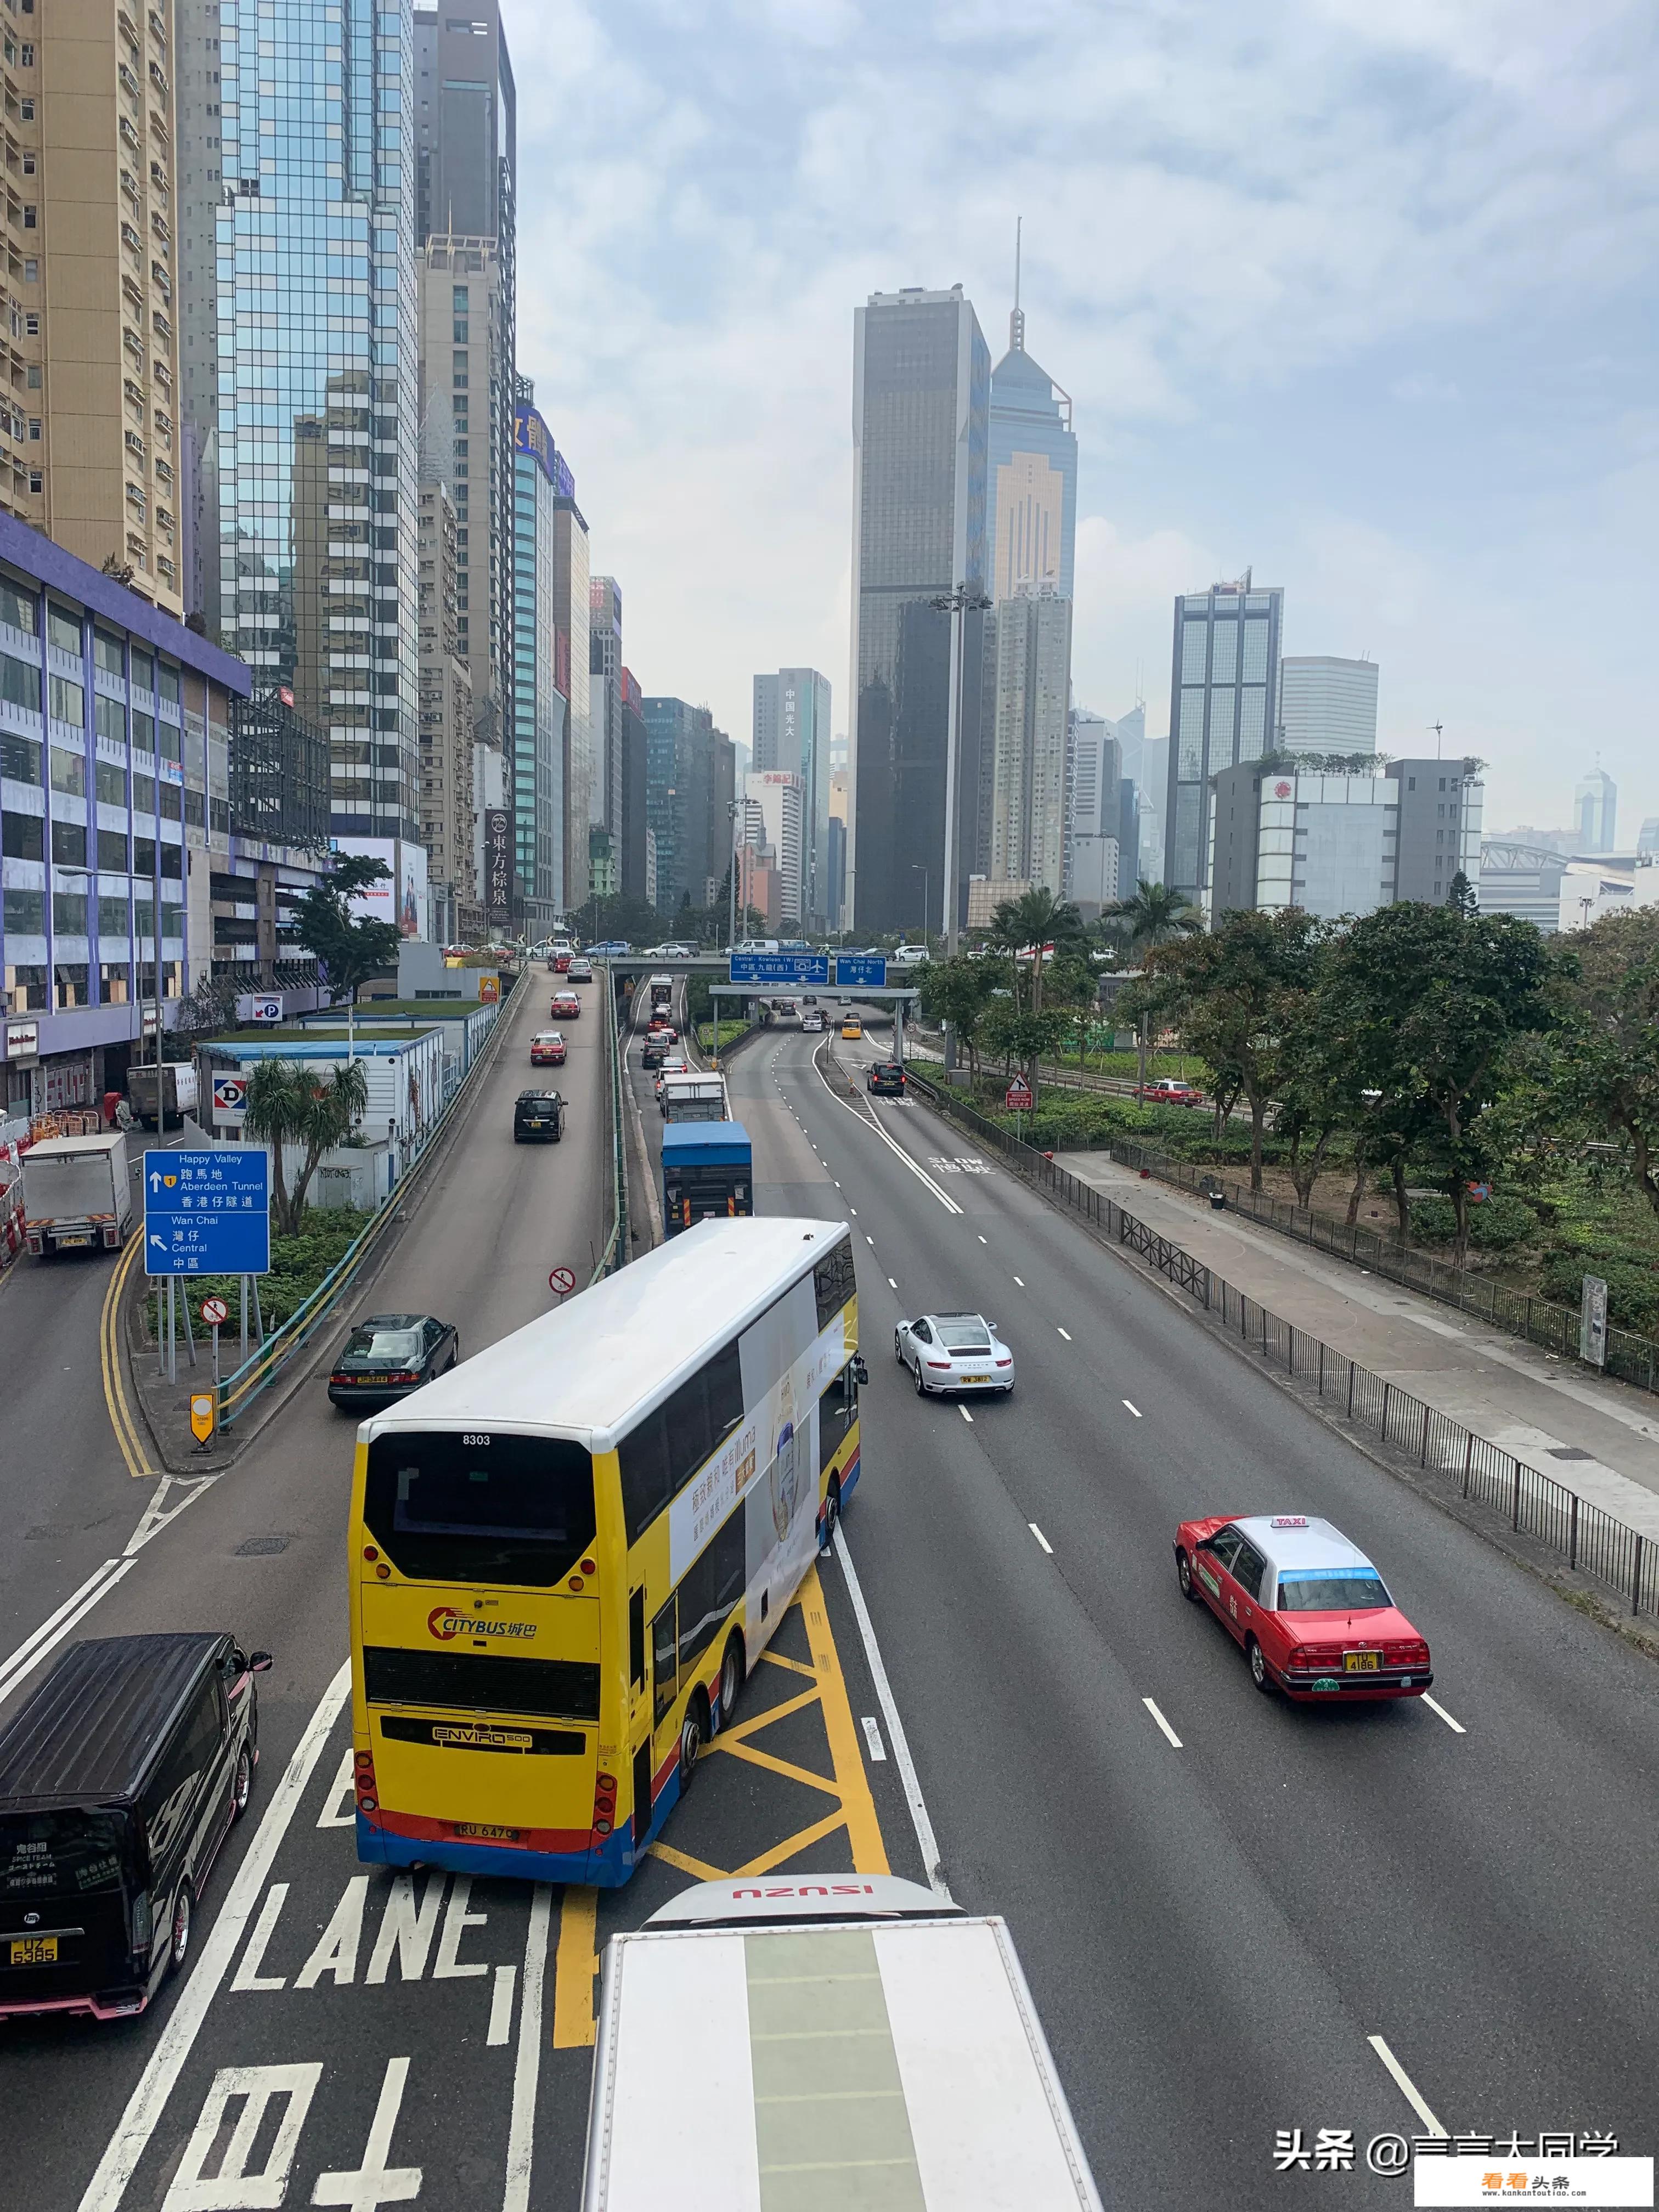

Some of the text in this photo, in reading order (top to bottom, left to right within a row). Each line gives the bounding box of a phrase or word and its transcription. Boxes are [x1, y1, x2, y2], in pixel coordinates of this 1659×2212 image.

[785, 689, 795, 736] 中国光大
[763, 774, 791, 784] 李錦記
[492, 834, 507, 905] 東方棕泉
[268, 1006, 275, 1016] P
[223, 1087, 239, 1101] D
[179, 1155, 242, 1165] Happy Valley
[932, 1163, 996, 1174] 慢駛
[181, 1169, 222, 1180] 跑馬地
[180, 1182, 263, 1190] Aberdeen Tunnel
[182, 1196, 252, 1207] 香港仔隧道
[172, 1216, 218, 1224] Wan Chai
[173, 1231, 199, 1242] 灣仔
[172, 1244, 207, 1252] Central
[173, 1257, 199, 1268] 中區
[463, 1435, 490, 1445] 8303
[443, 1618, 537, 1637] CITYBUS 城巴
[1350, 1661, 1373, 1670] 4186
[461, 1825, 477, 1835] RU
[733, 1885, 874, 1899] ISUZU
[229, 1875, 488, 1991] LANE
[24, 1938, 44, 1951] UZ
[14, 1949, 54, 1964] 5385
